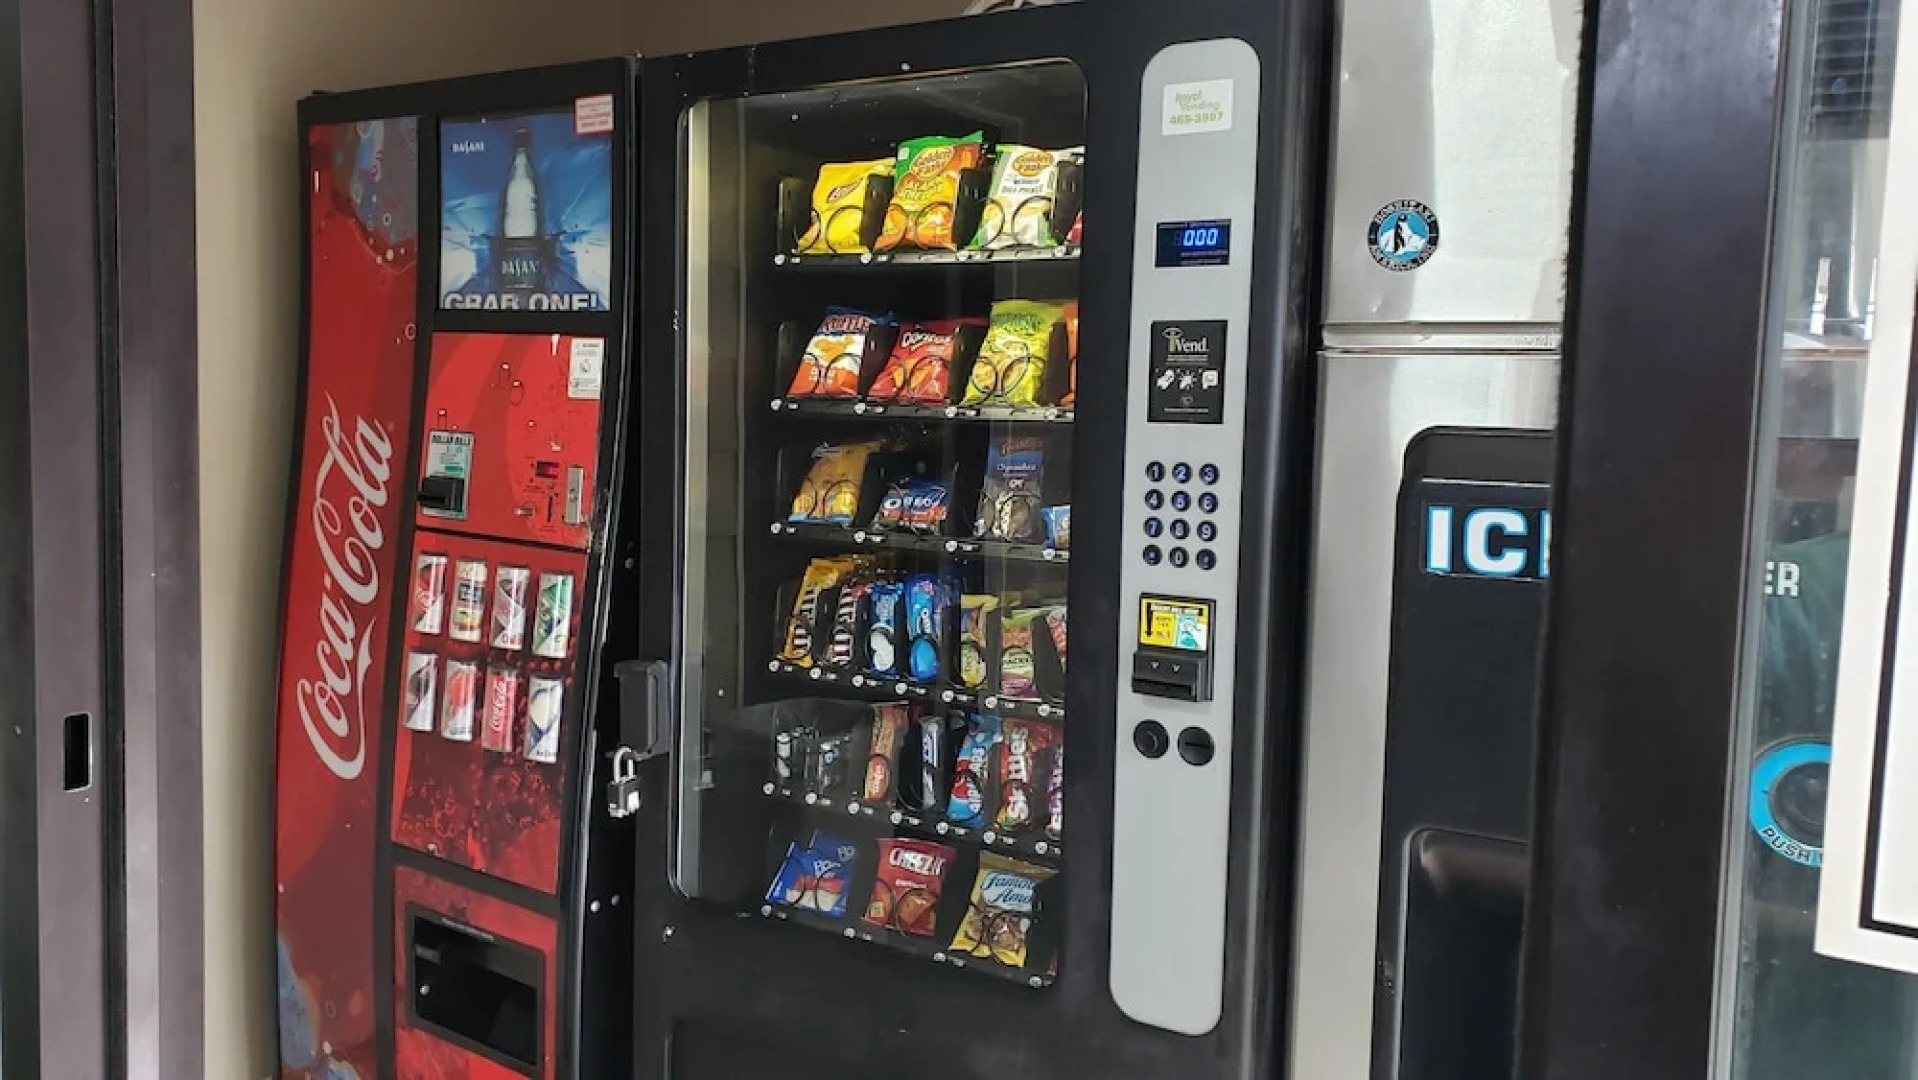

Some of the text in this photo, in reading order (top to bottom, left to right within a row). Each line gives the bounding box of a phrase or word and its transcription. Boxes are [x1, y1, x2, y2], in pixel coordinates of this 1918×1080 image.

[453, 139, 485, 154] DASANI
[1183, 228, 1218, 246] 000
[1427, 505, 1551, 578] IC
[297, 391, 392, 780] Coca-Cola
[1761, 827, 1810, 862] PUSH
